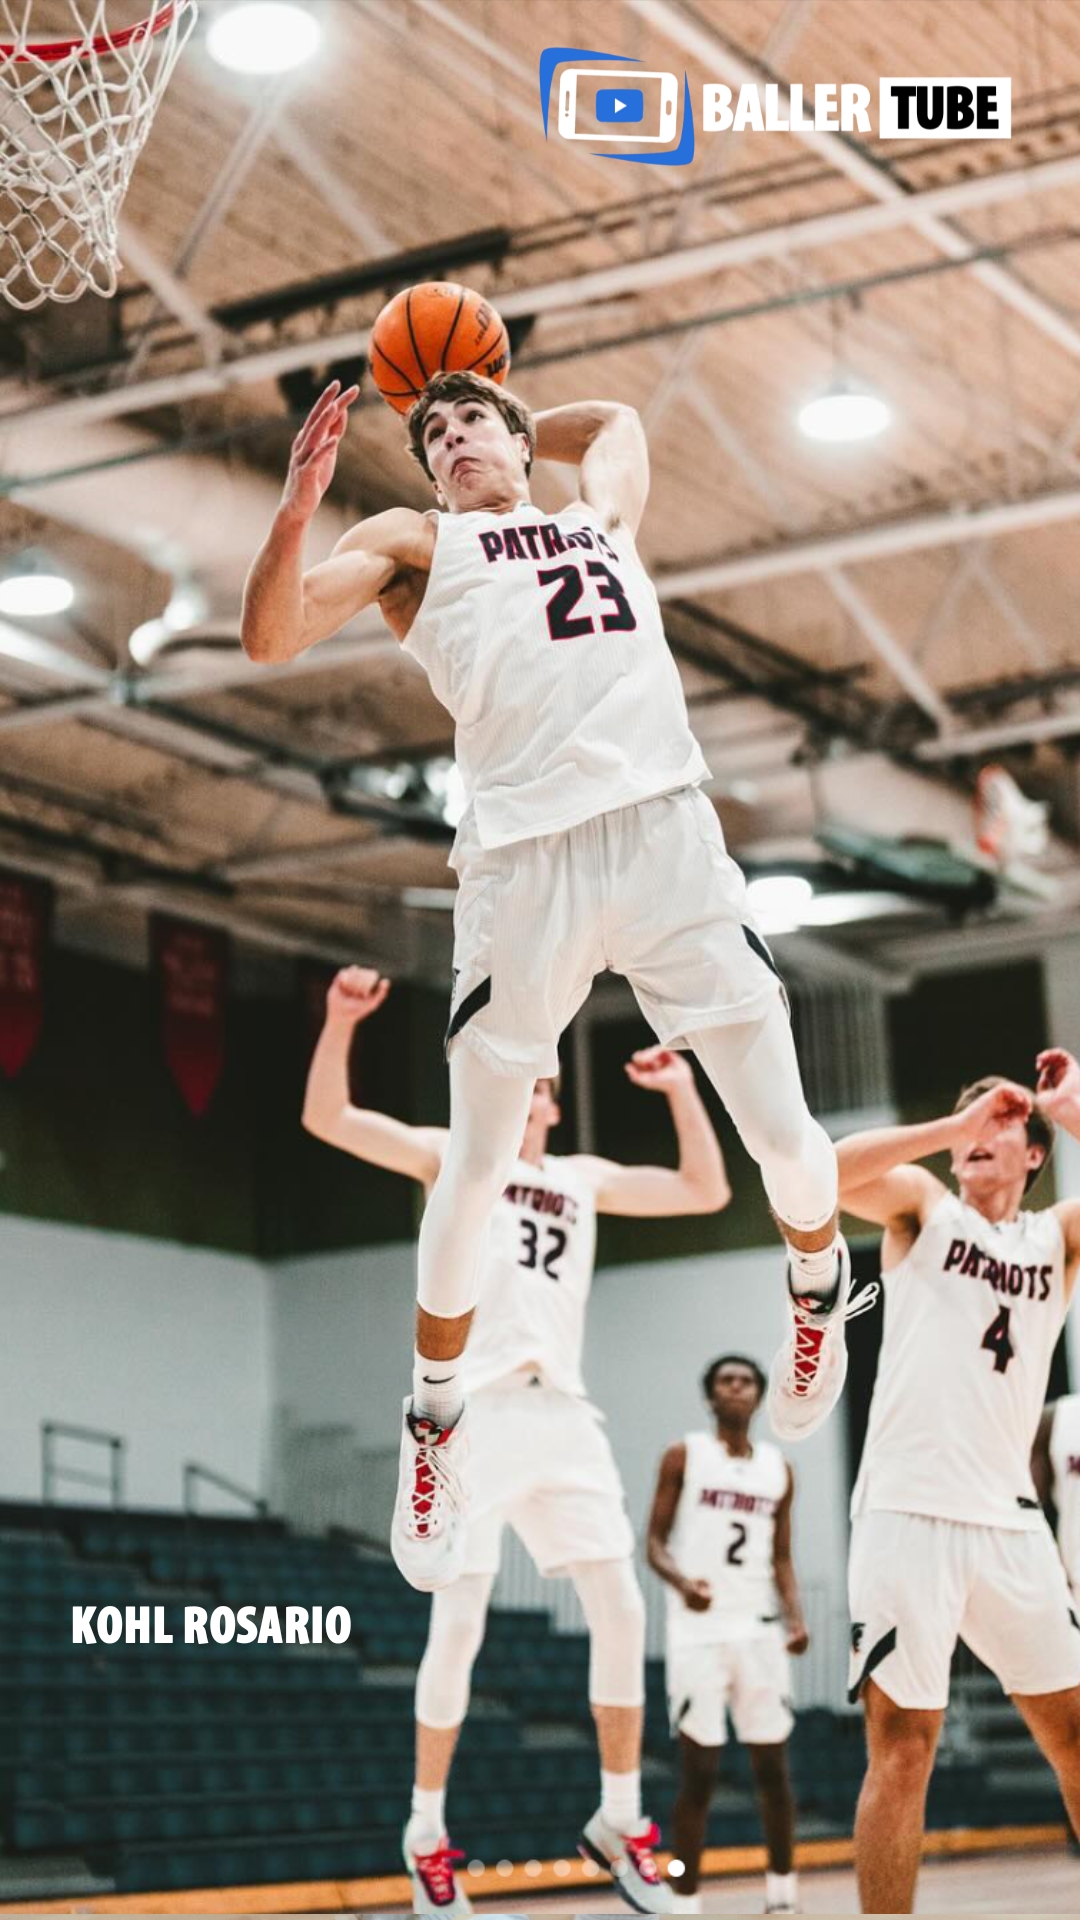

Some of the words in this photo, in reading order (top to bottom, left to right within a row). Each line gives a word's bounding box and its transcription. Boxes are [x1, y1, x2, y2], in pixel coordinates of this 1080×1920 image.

[478, 523, 620, 563] PATRIOS
[536, 559, 637, 641] 23
[502, 1183, 578, 1227] ATRIOS
[517, 1218, 567, 1282] 32
[942, 1238, 1053, 1302] PATRIOTS
[980, 1304, 1015, 1375] 4
[726, 1521, 747, 1567] 2
